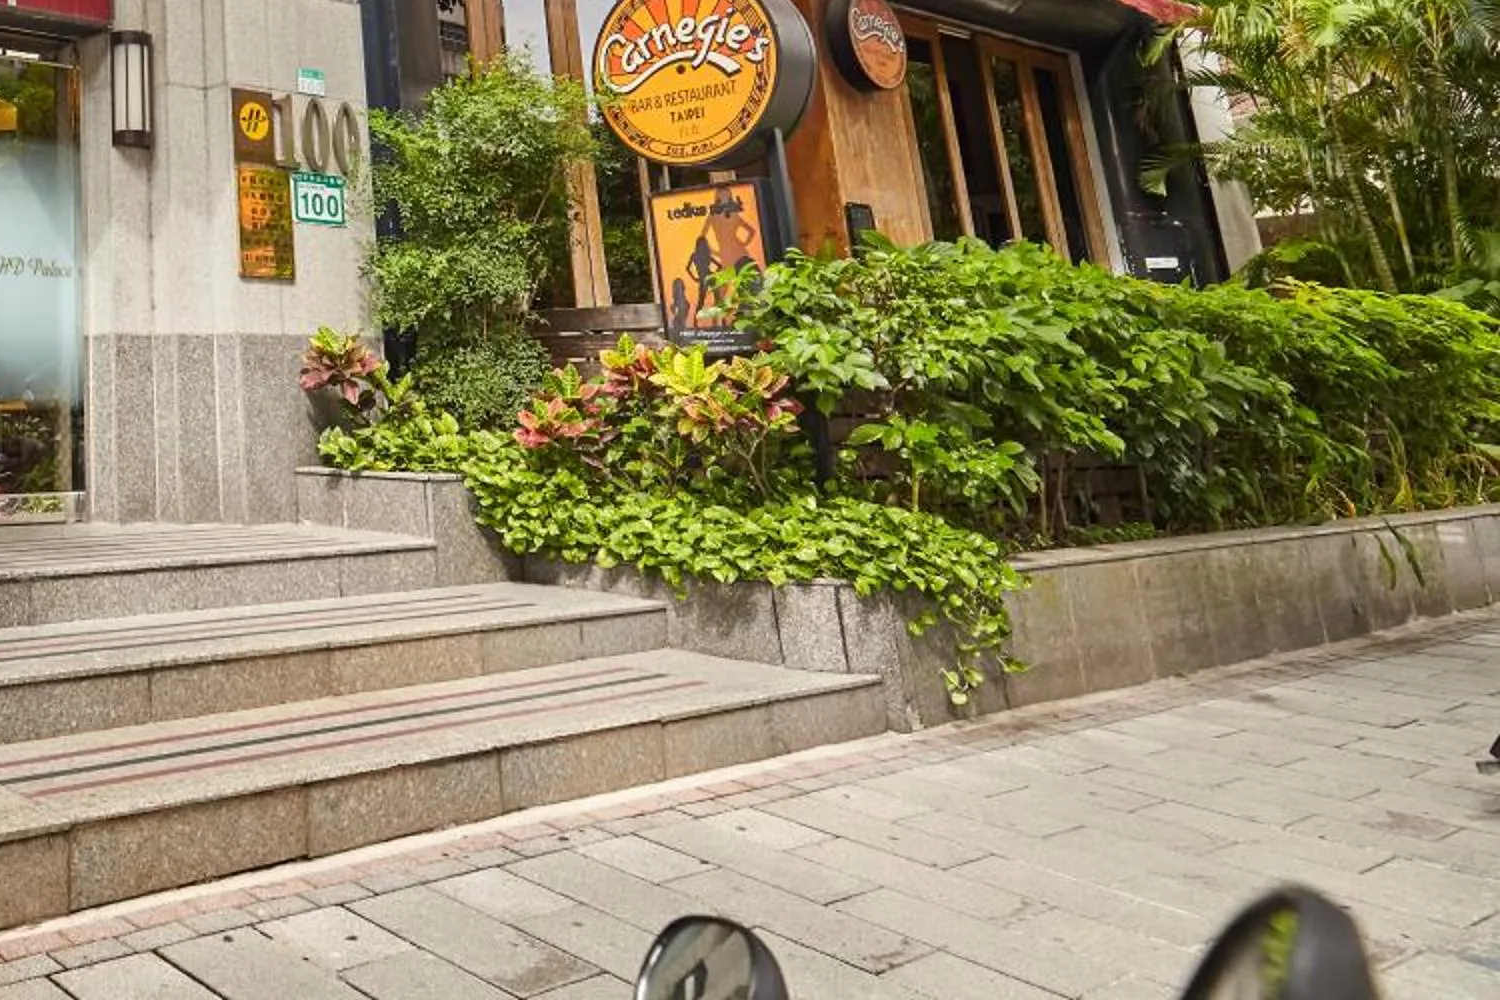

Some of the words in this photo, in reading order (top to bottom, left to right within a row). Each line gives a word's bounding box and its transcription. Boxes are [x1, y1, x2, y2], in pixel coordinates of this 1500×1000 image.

[630, 97, 652, 114] BAR
[663, 80, 737, 109] RESTAURANT
[670, 107, 706, 124] TAIPEI
[271, 93, 361, 174] 100
[300, 192, 339, 218] 100
